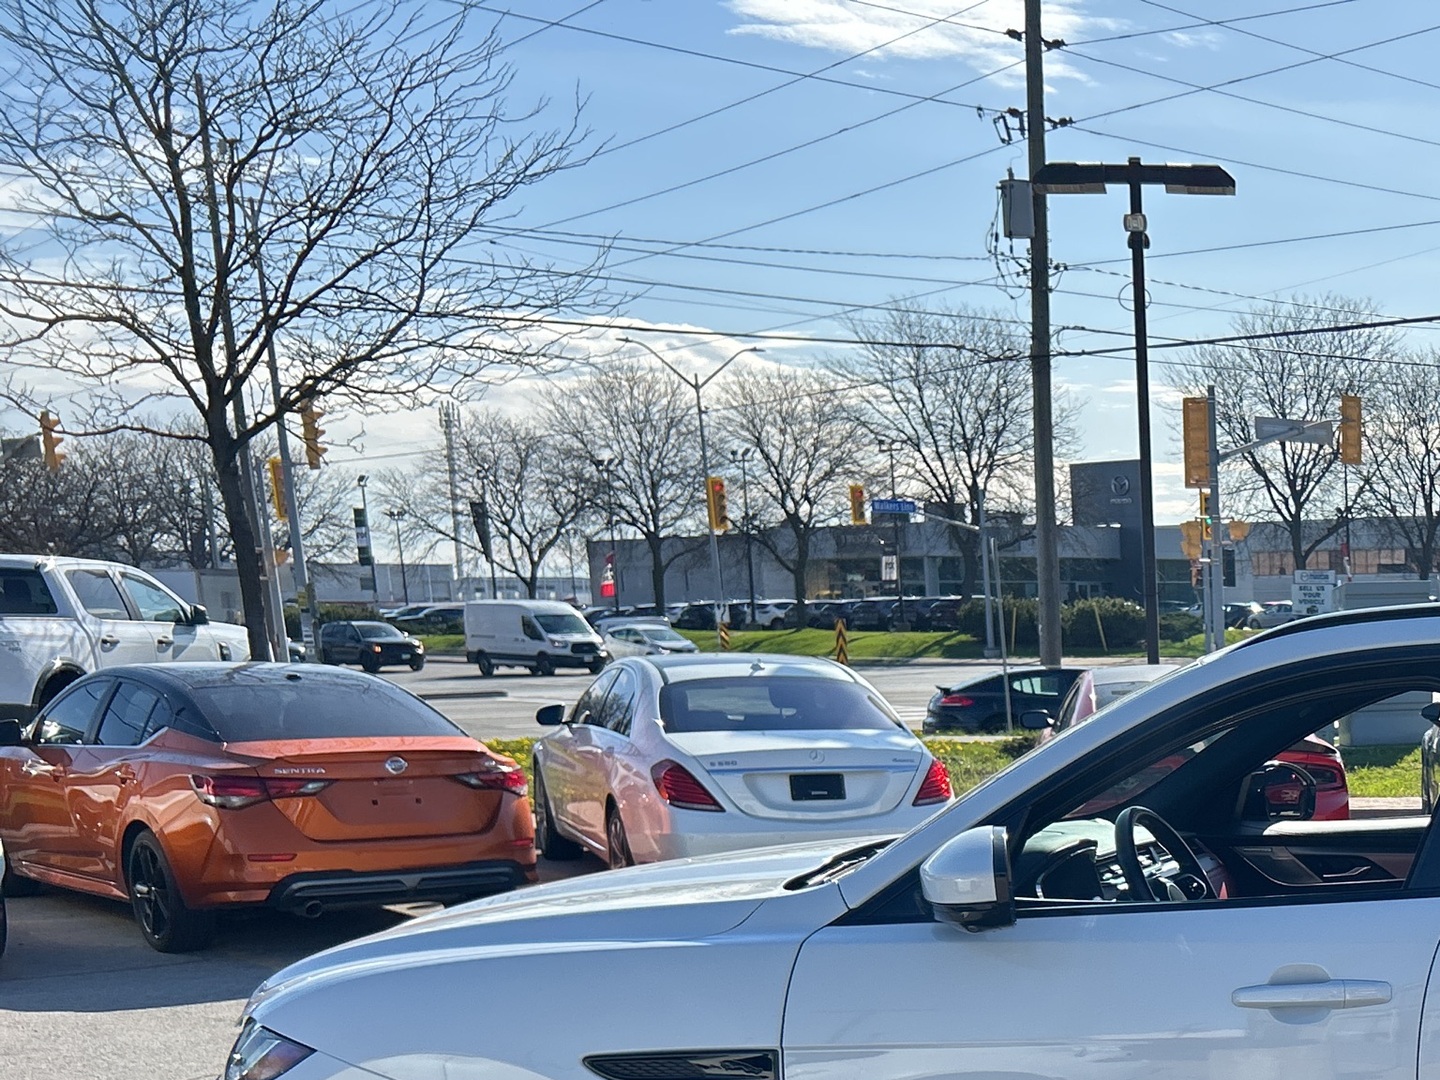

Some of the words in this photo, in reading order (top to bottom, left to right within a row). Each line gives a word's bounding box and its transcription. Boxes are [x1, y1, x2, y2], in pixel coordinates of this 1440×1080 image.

[874, 501, 899, 510] Walkers
[901, 502, 914, 510] Line
[274, 767, 326, 775] SENTRA
